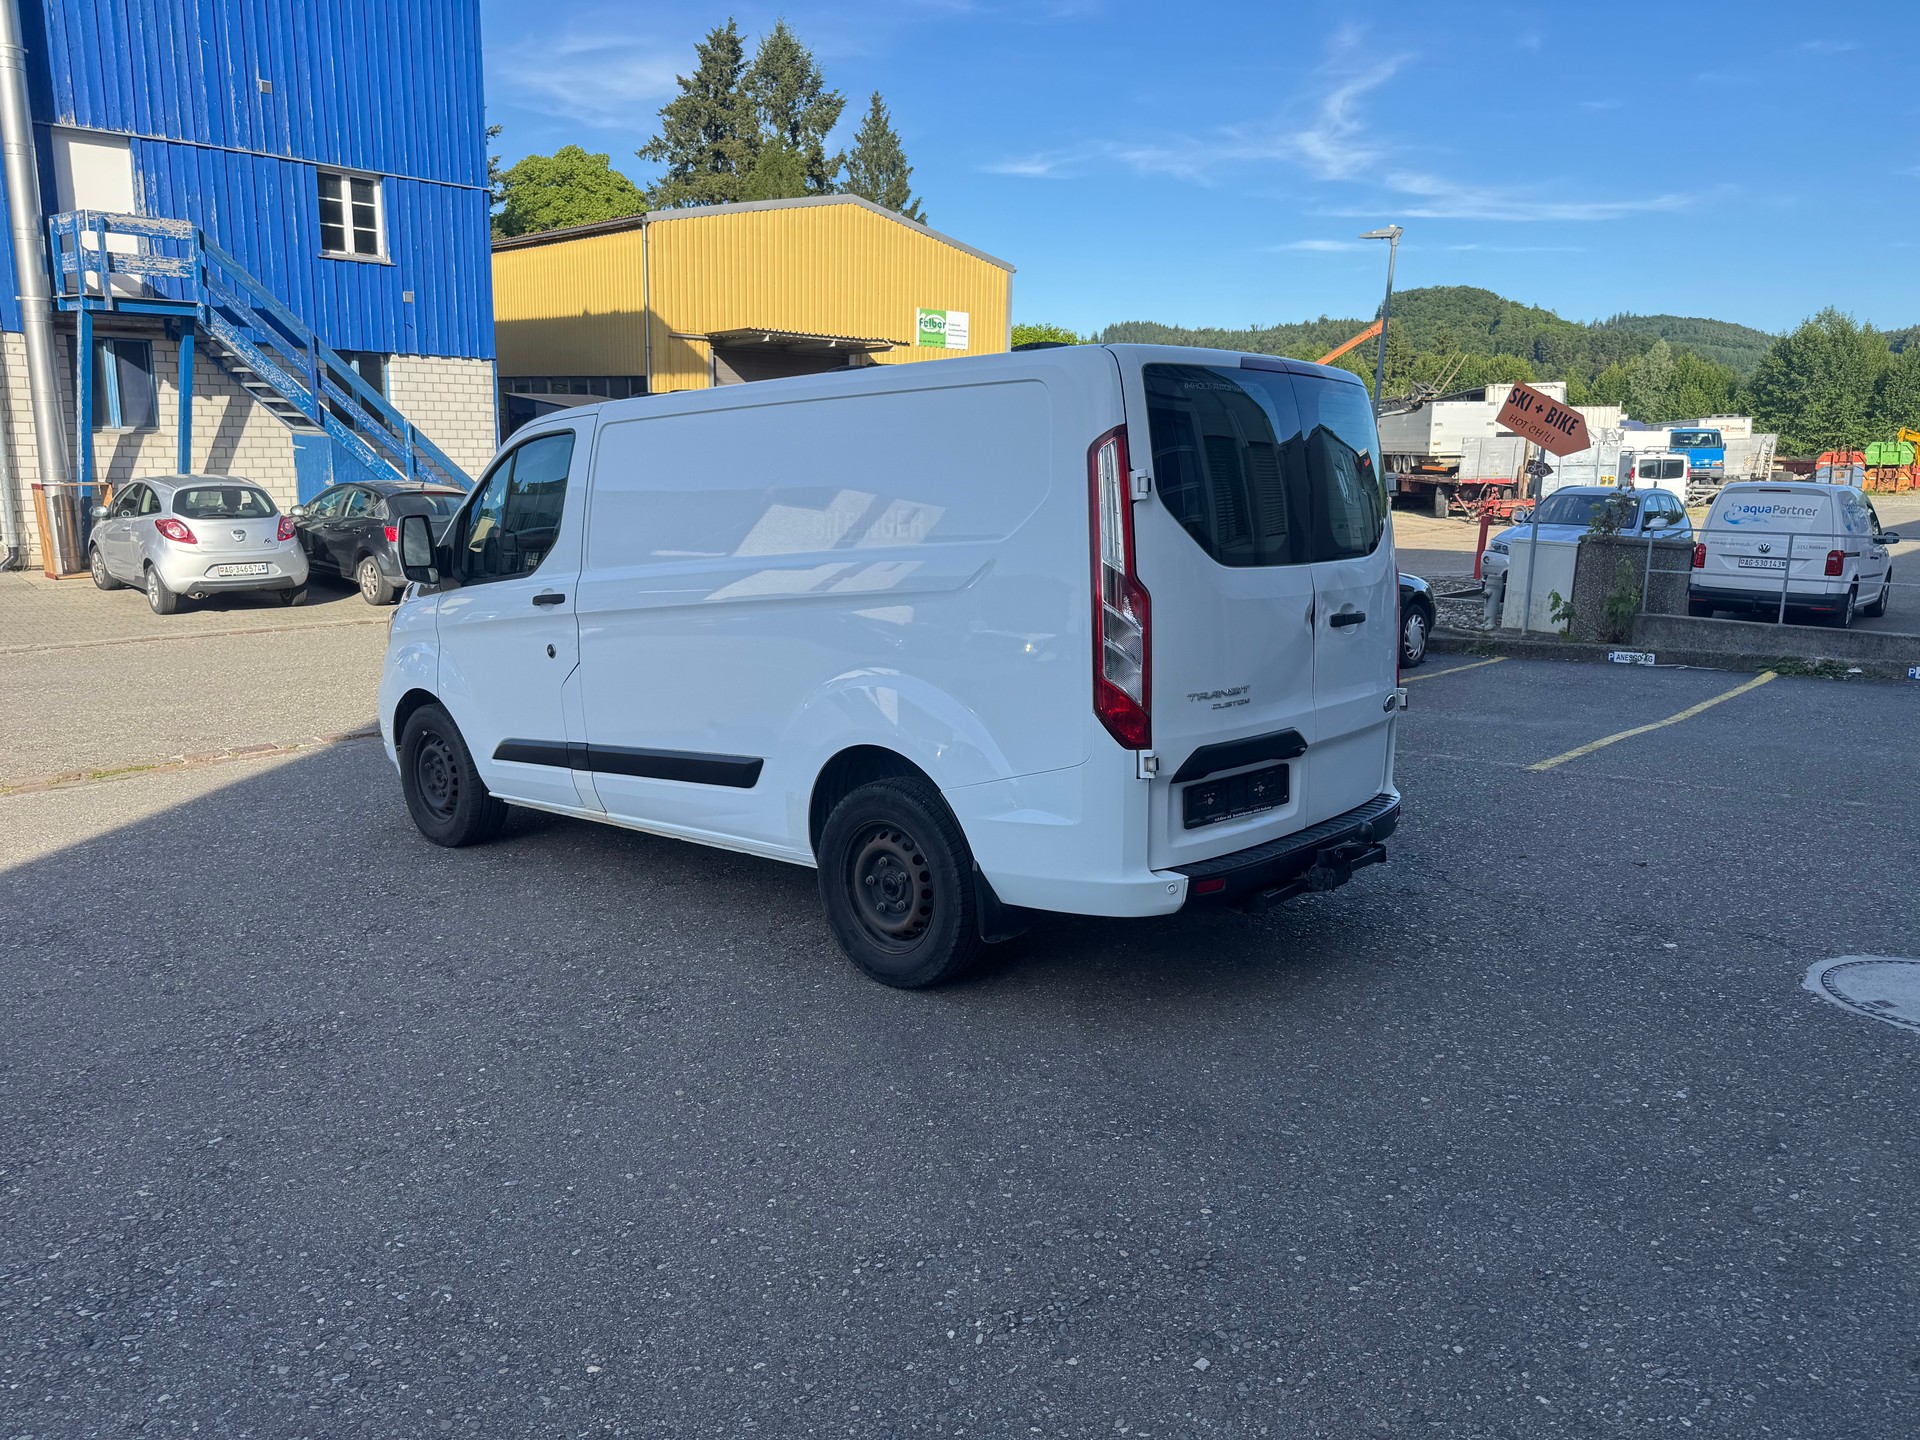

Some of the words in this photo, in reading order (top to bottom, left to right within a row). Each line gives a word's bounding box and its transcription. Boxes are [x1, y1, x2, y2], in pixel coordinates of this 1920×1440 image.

[1508, 388, 1534, 412] SKI
[1544, 406, 1579, 436] BIKE
[1508, 414, 1530, 429] HOT
[1742, 504, 1818, 517] aquaPartner
[1908, 667, 1916, 677] P
[1187, 685, 1250, 702] TRANSIT
